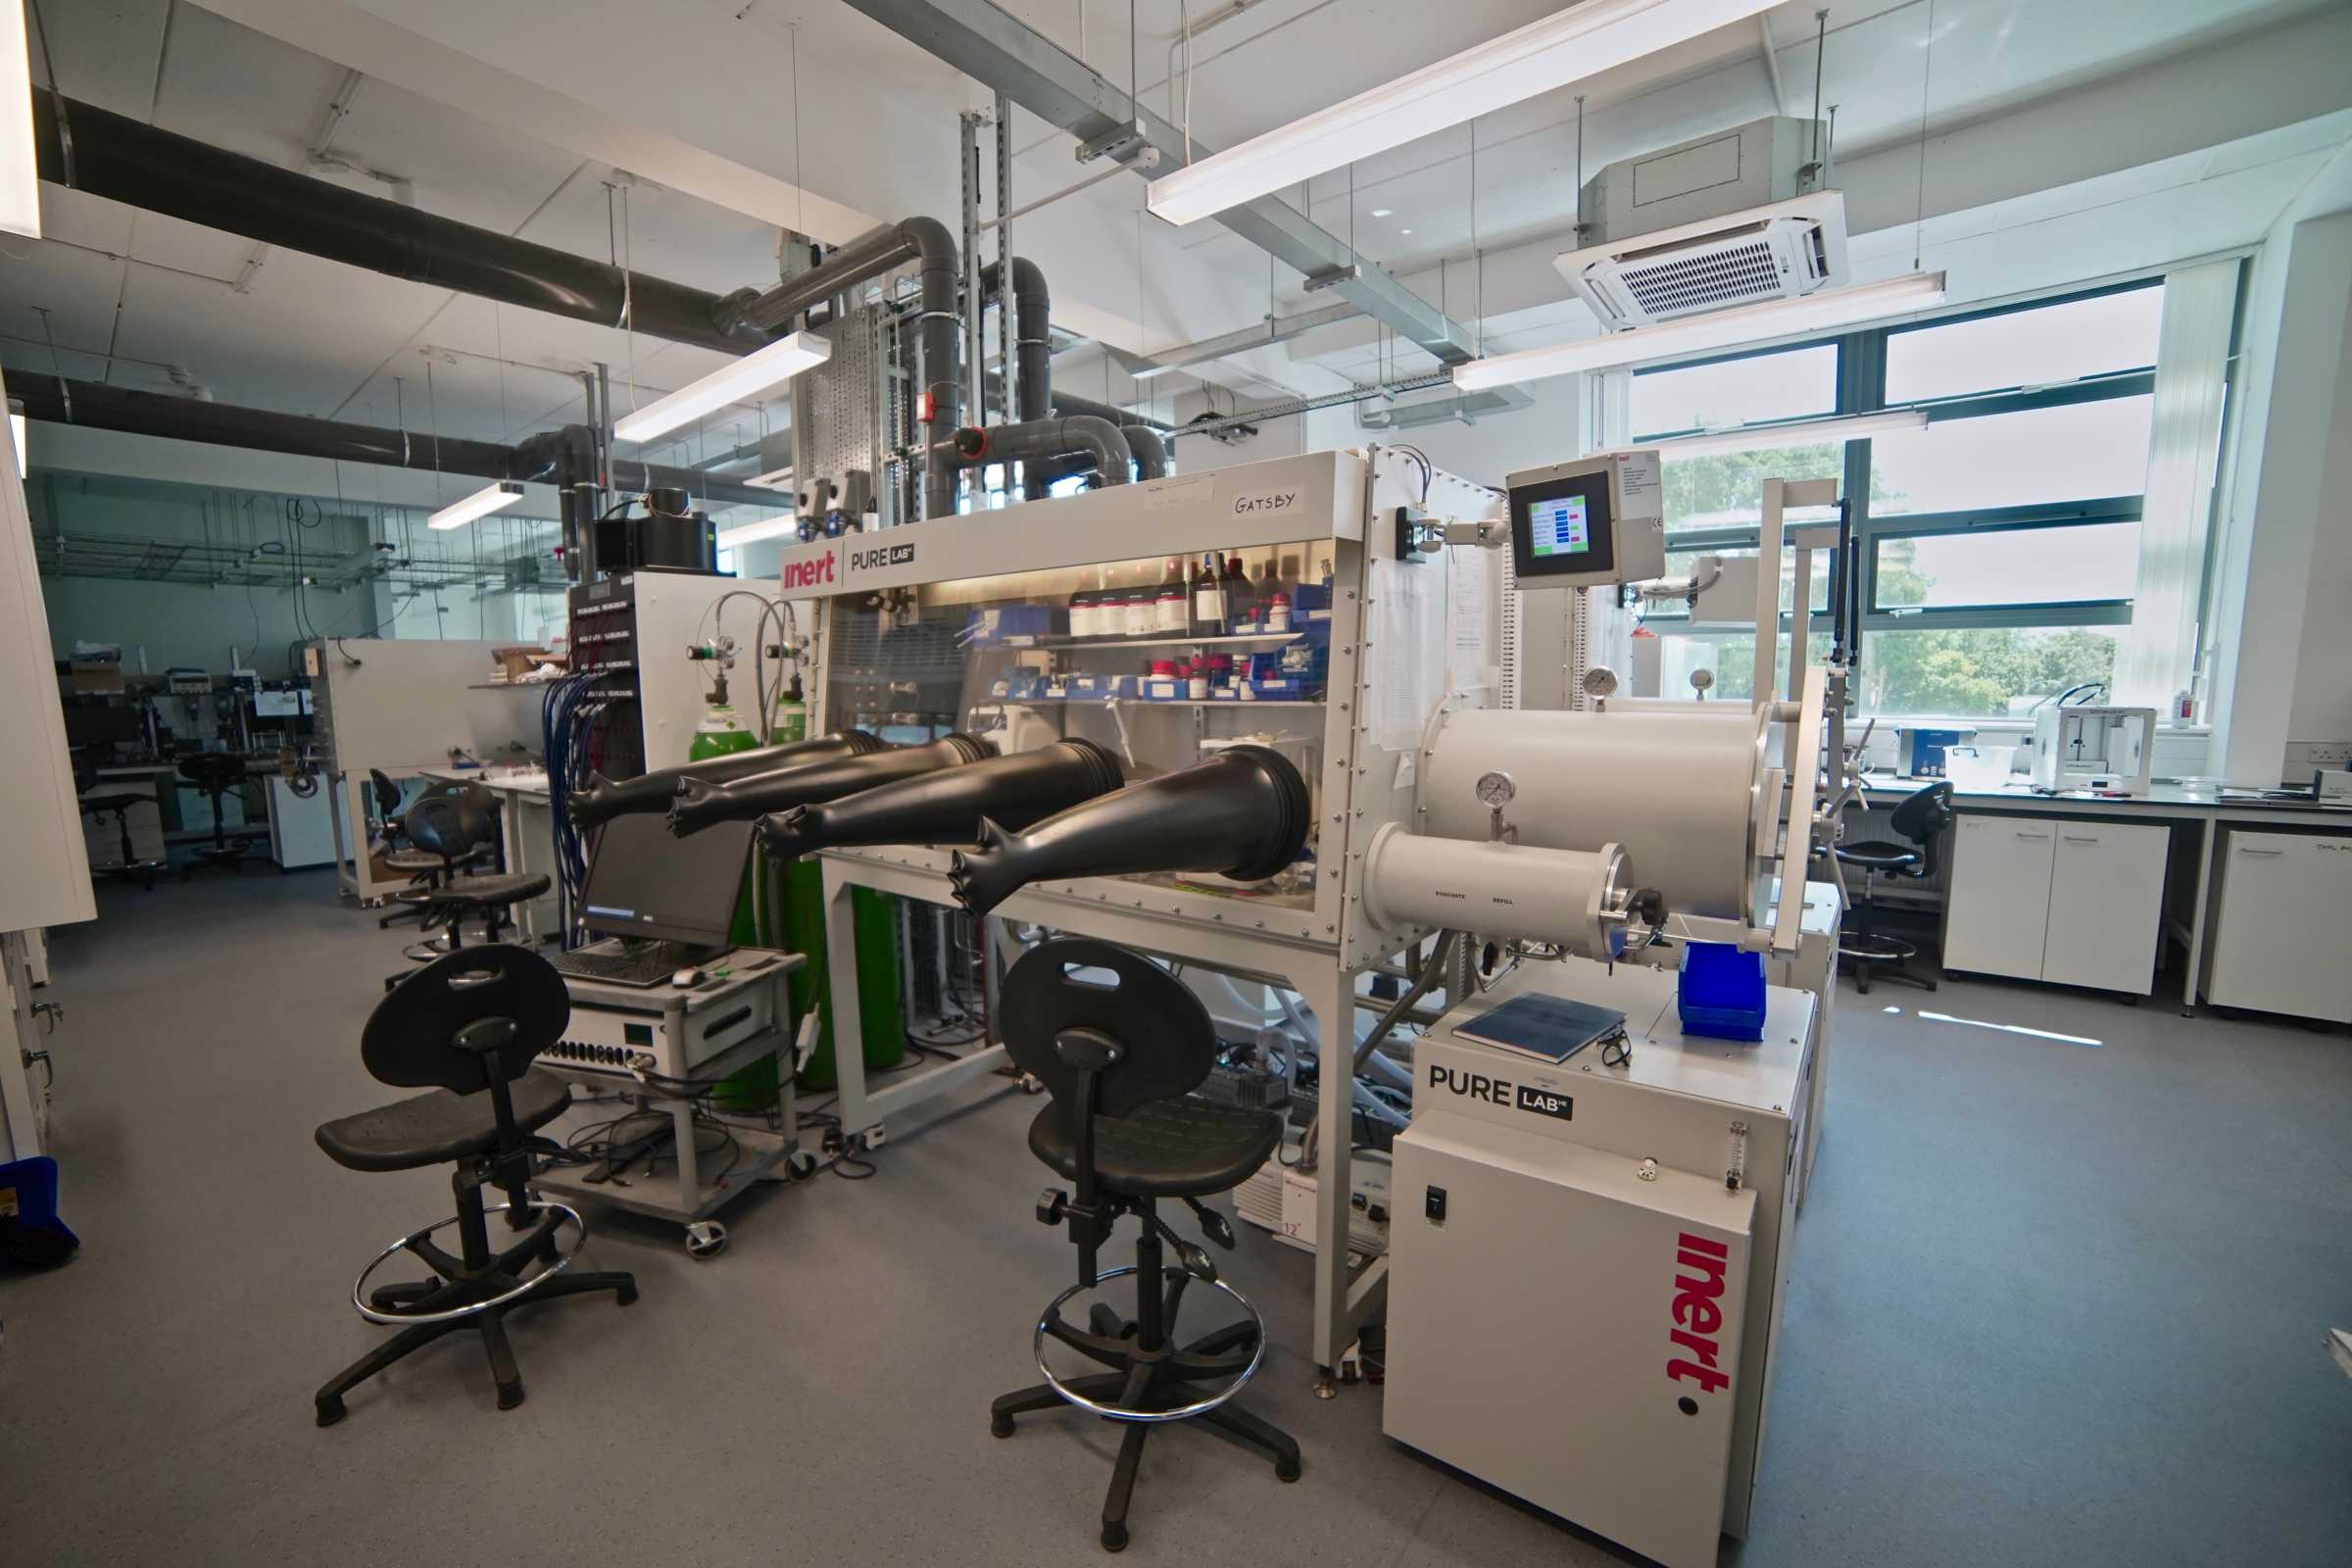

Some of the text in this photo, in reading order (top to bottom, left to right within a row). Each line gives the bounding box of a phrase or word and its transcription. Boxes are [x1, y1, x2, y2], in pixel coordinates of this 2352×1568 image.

[1235, 493, 1296, 514] GATSBY
[851, 547, 888, 571] PURE
[1435, 890, 1513, 906] EVACUATE REFILL
[1429, 1064, 1512, 1107] PURE
